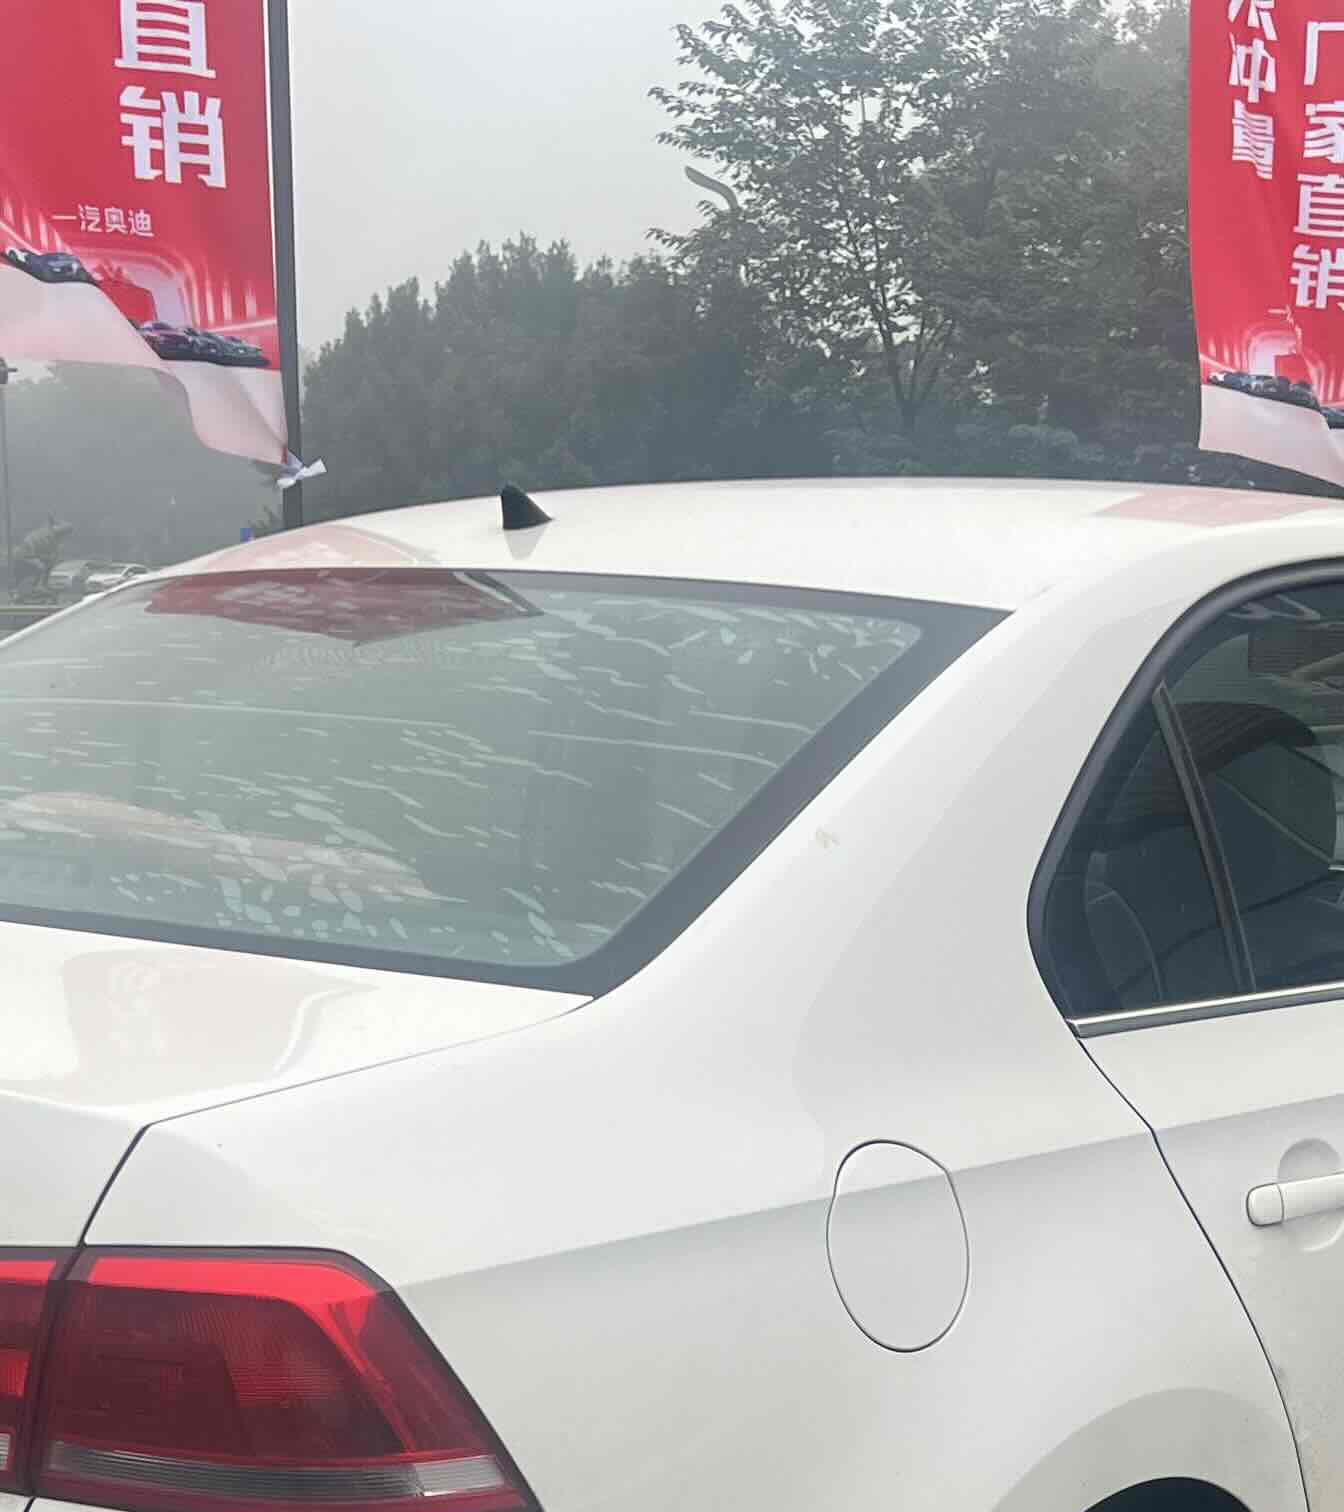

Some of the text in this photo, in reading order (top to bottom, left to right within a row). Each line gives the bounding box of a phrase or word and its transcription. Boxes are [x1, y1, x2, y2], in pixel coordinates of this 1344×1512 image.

[114, 0, 227, 189] 直销
[52, 204, 155, 237] 一汽奥迪
